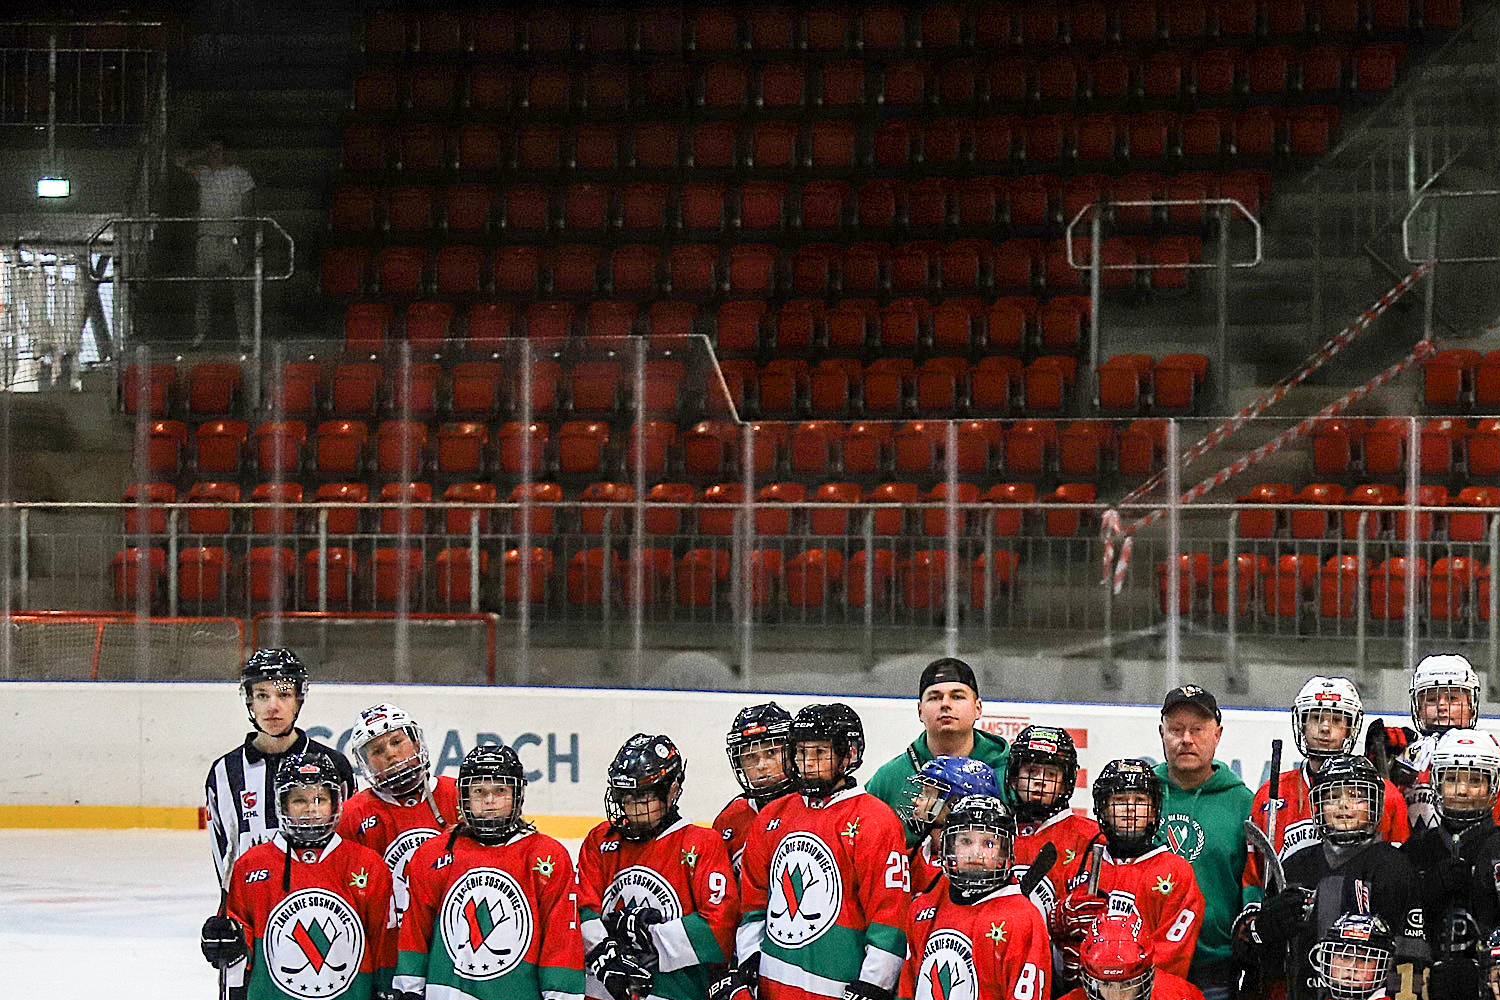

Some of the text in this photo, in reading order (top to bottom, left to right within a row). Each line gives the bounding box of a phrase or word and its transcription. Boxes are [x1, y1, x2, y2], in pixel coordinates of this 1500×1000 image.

[484, 875, 522, 911] SOSNOWIEC
[708, 872, 727, 905] 9
[308, 896, 351, 927] SOSNOWIEC
[1166, 908, 1196, 942] 8
